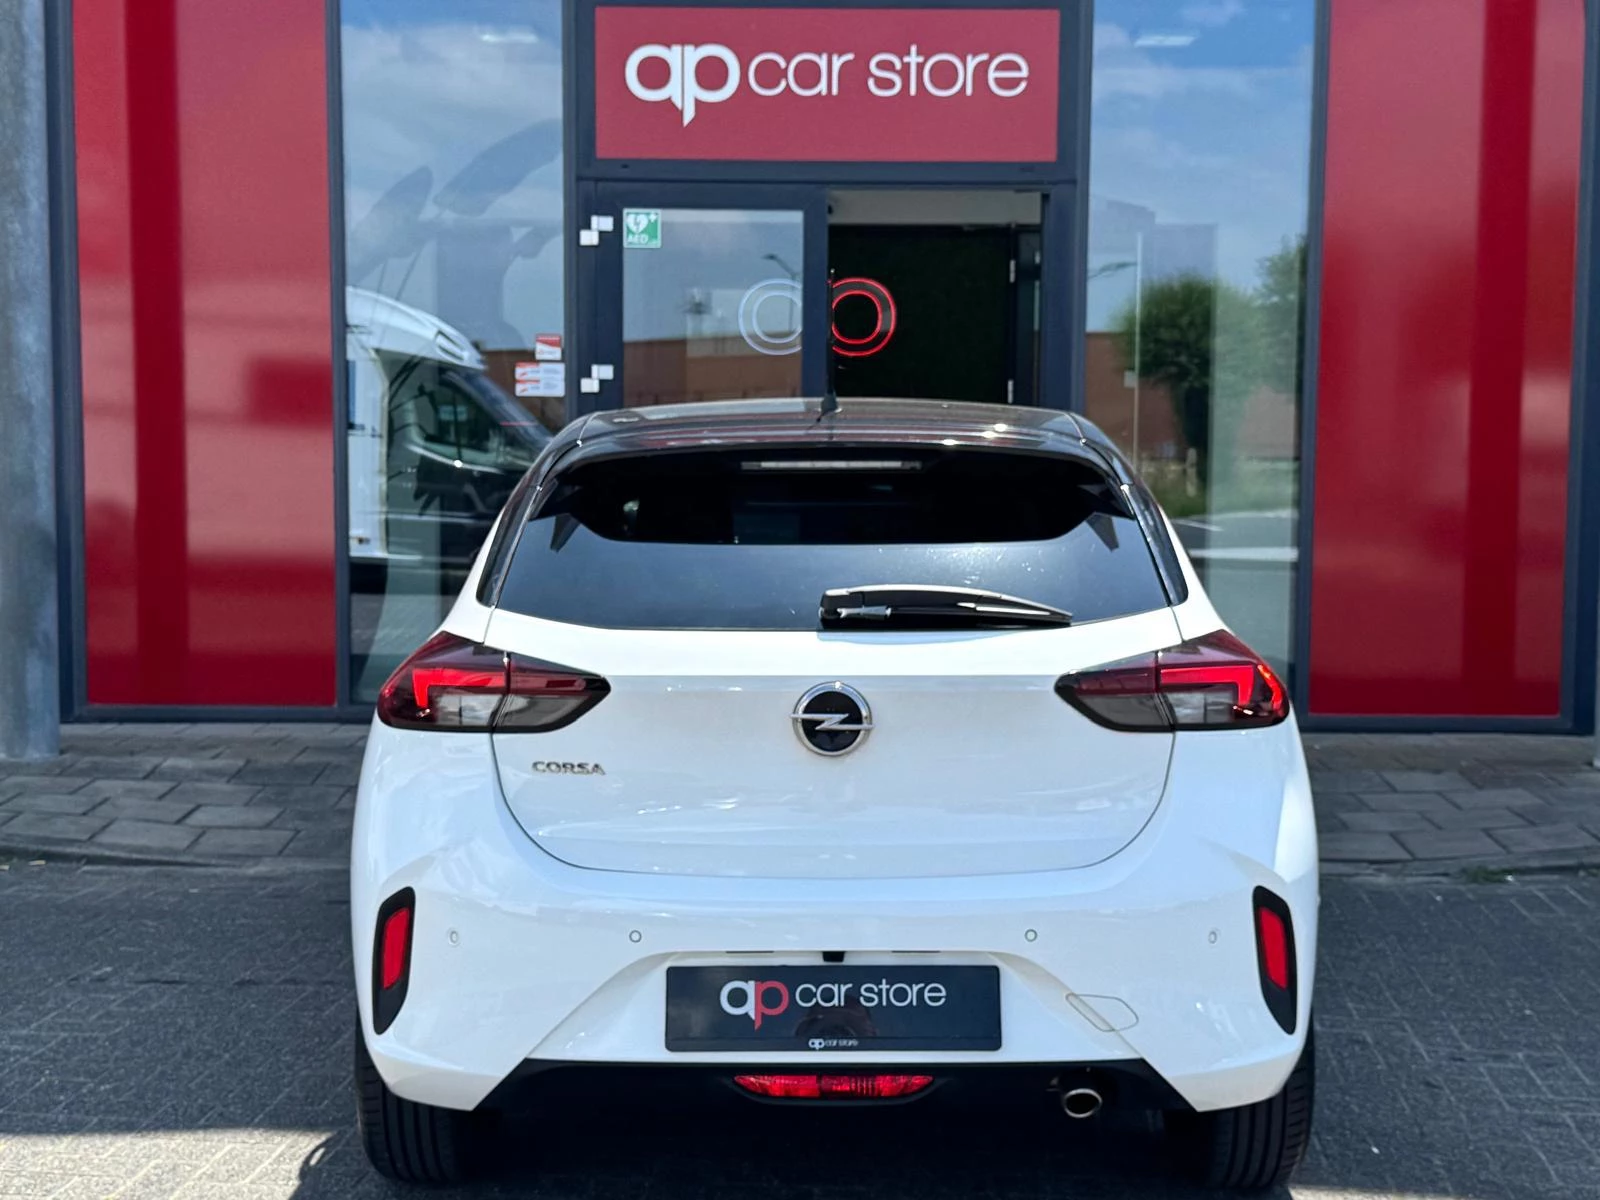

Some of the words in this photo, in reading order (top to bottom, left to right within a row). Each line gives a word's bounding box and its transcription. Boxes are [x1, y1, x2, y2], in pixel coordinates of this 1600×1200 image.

[748, 52, 854, 97] car
[867, 44, 1030, 97] store
[532, 761, 606, 776] CORSA
[795, 982, 853, 1007] car
[859, 979, 947, 1007] store
